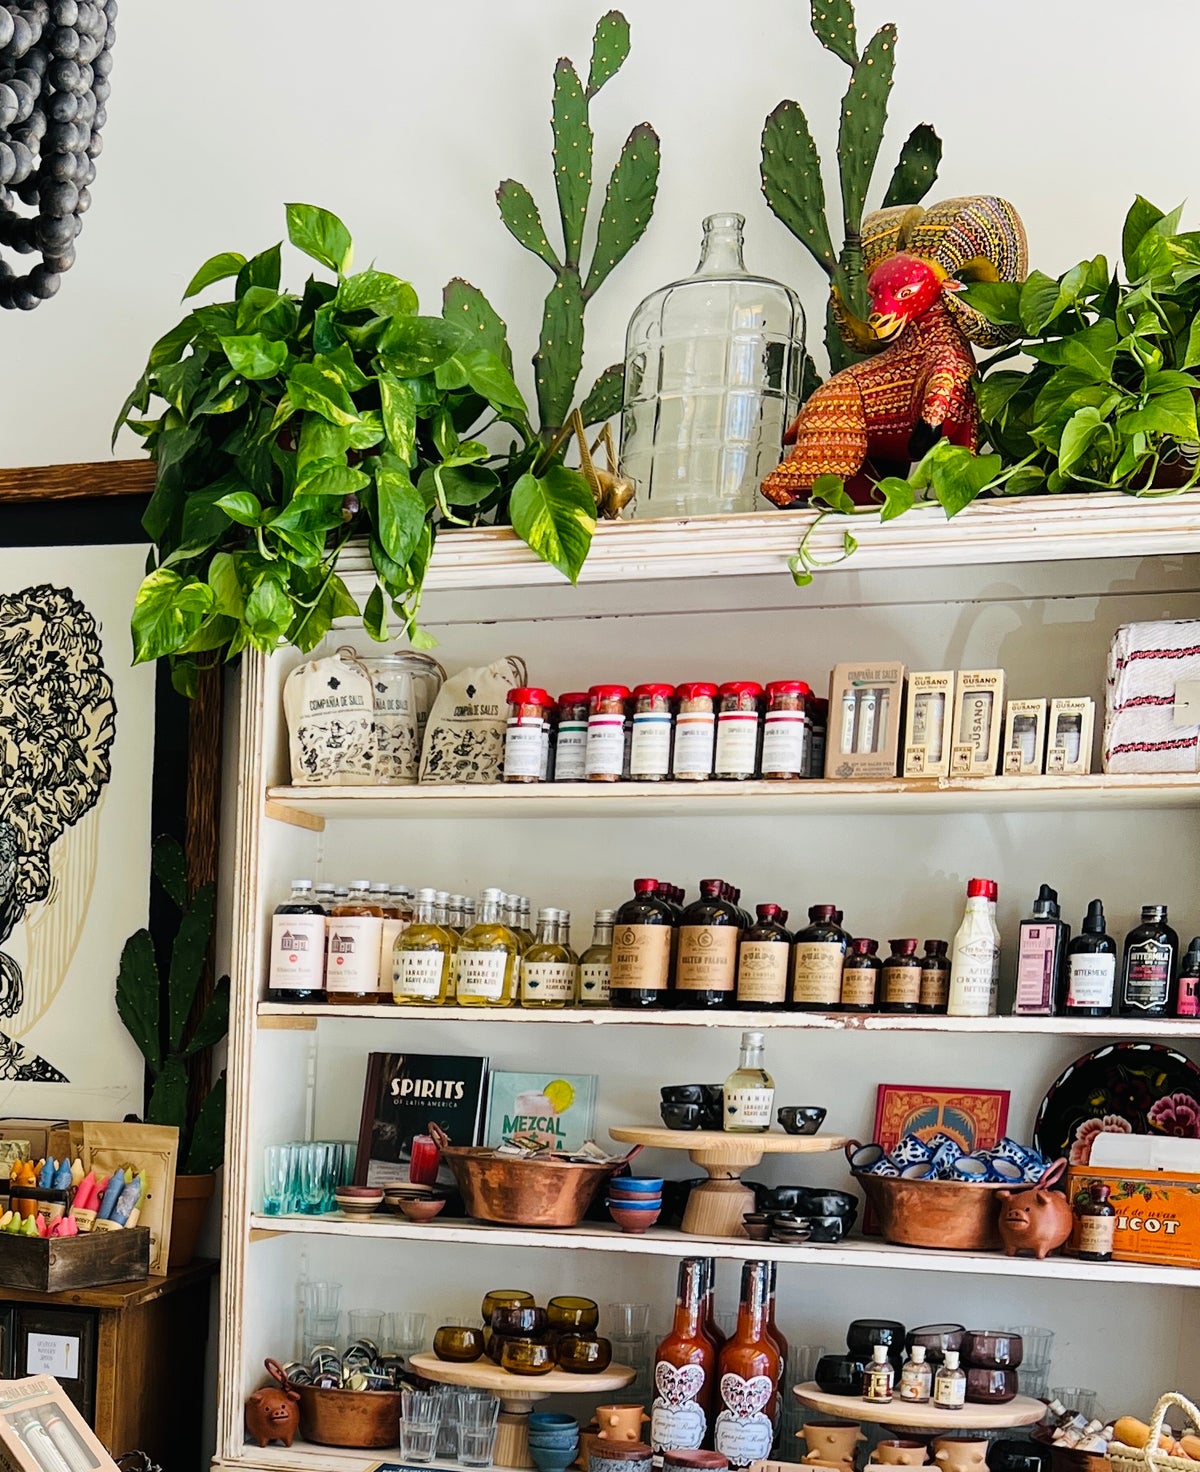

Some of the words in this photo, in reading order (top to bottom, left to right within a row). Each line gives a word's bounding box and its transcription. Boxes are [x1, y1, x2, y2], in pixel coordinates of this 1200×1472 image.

[881, 669, 898, 679] SALES
[390, 1078, 465, 1100] SPIRITS
[502, 1115, 567, 1137] MEZCAL
[1117, 1216, 1181, 1234] ICOT
